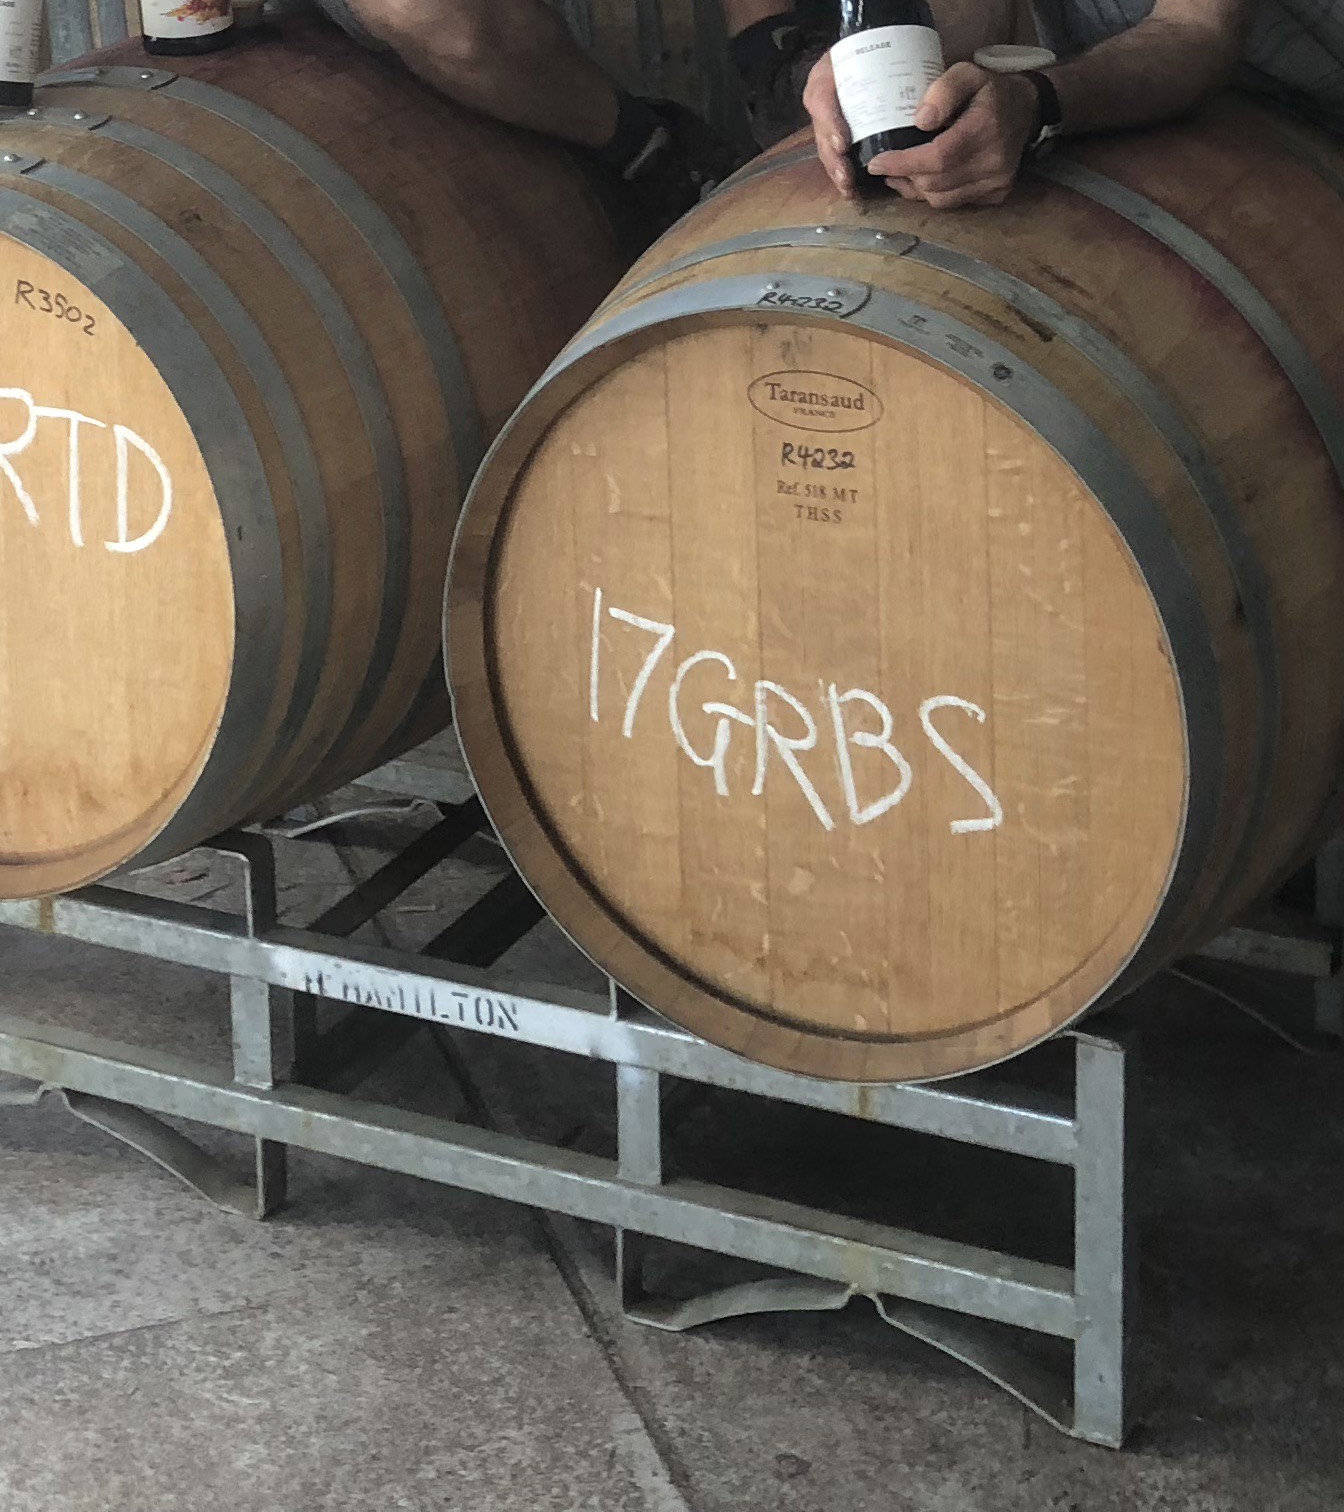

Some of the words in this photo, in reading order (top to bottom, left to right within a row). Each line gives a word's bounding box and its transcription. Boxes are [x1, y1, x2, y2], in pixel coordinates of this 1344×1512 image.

[15, 279, 96, 336] R3502
[764, 382, 866, 412] Taransaud
[781, 441, 857, 471] R4232
[589, 586, 1004, 836] 17GRBS
